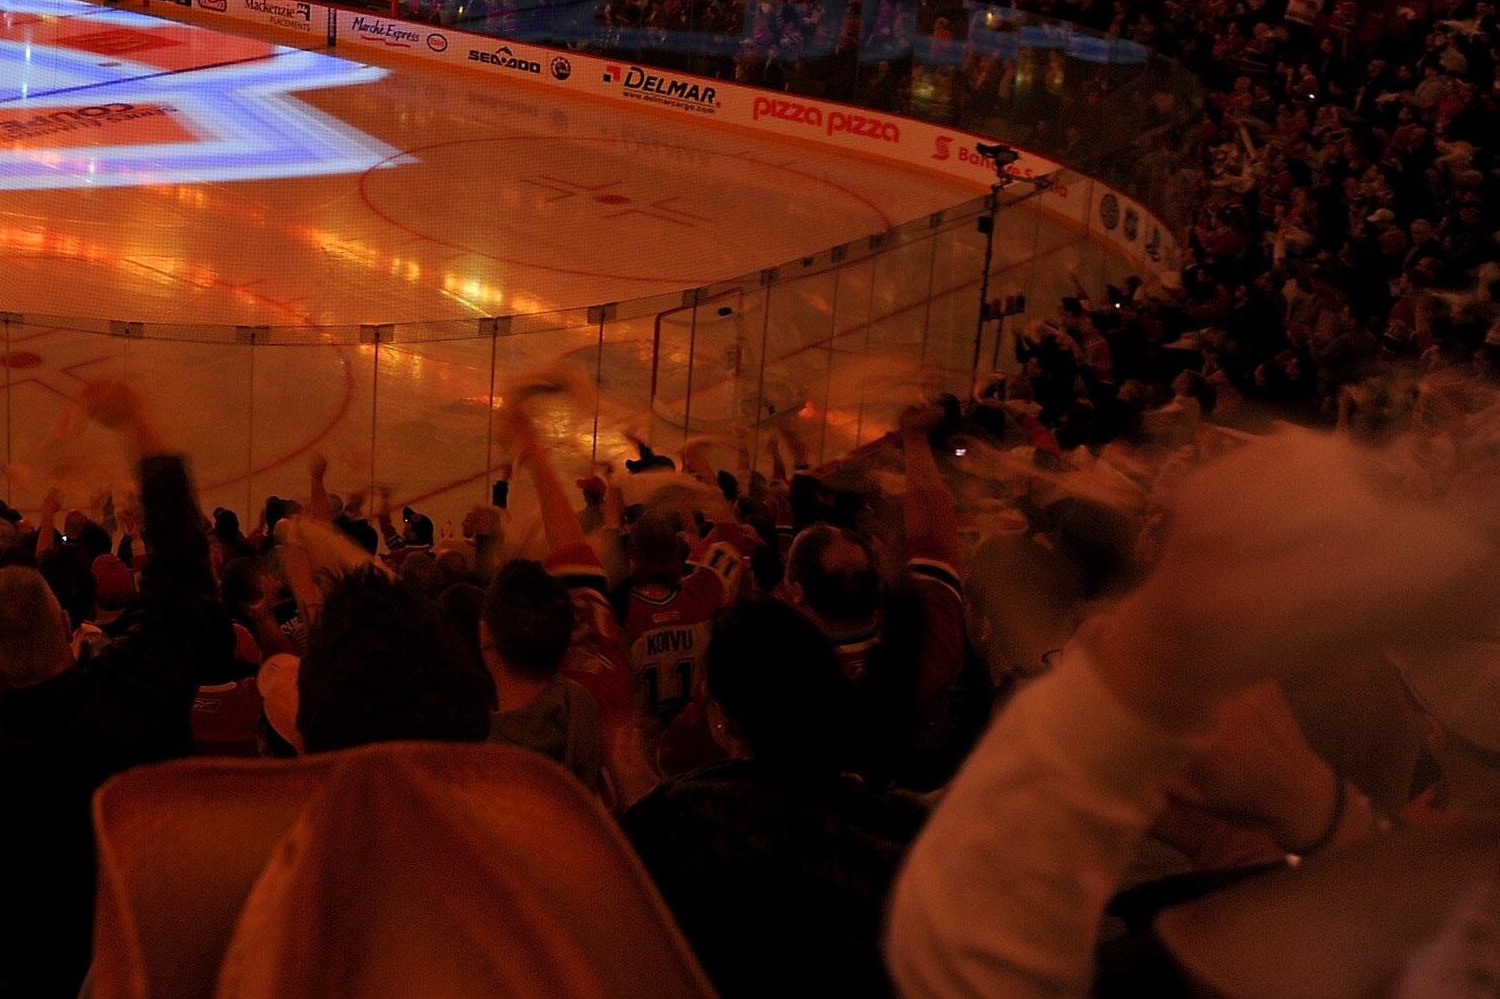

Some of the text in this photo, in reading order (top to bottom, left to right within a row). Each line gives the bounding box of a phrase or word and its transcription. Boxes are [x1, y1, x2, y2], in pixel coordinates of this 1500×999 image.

[352, 17, 385, 36] Marché
[386, 21, 420, 43] Express
[624, 67, 717, 104] DELMAR
[753, 97, 900, 143] pizza pizza
[646, 630, 693, 656] KOIVU
